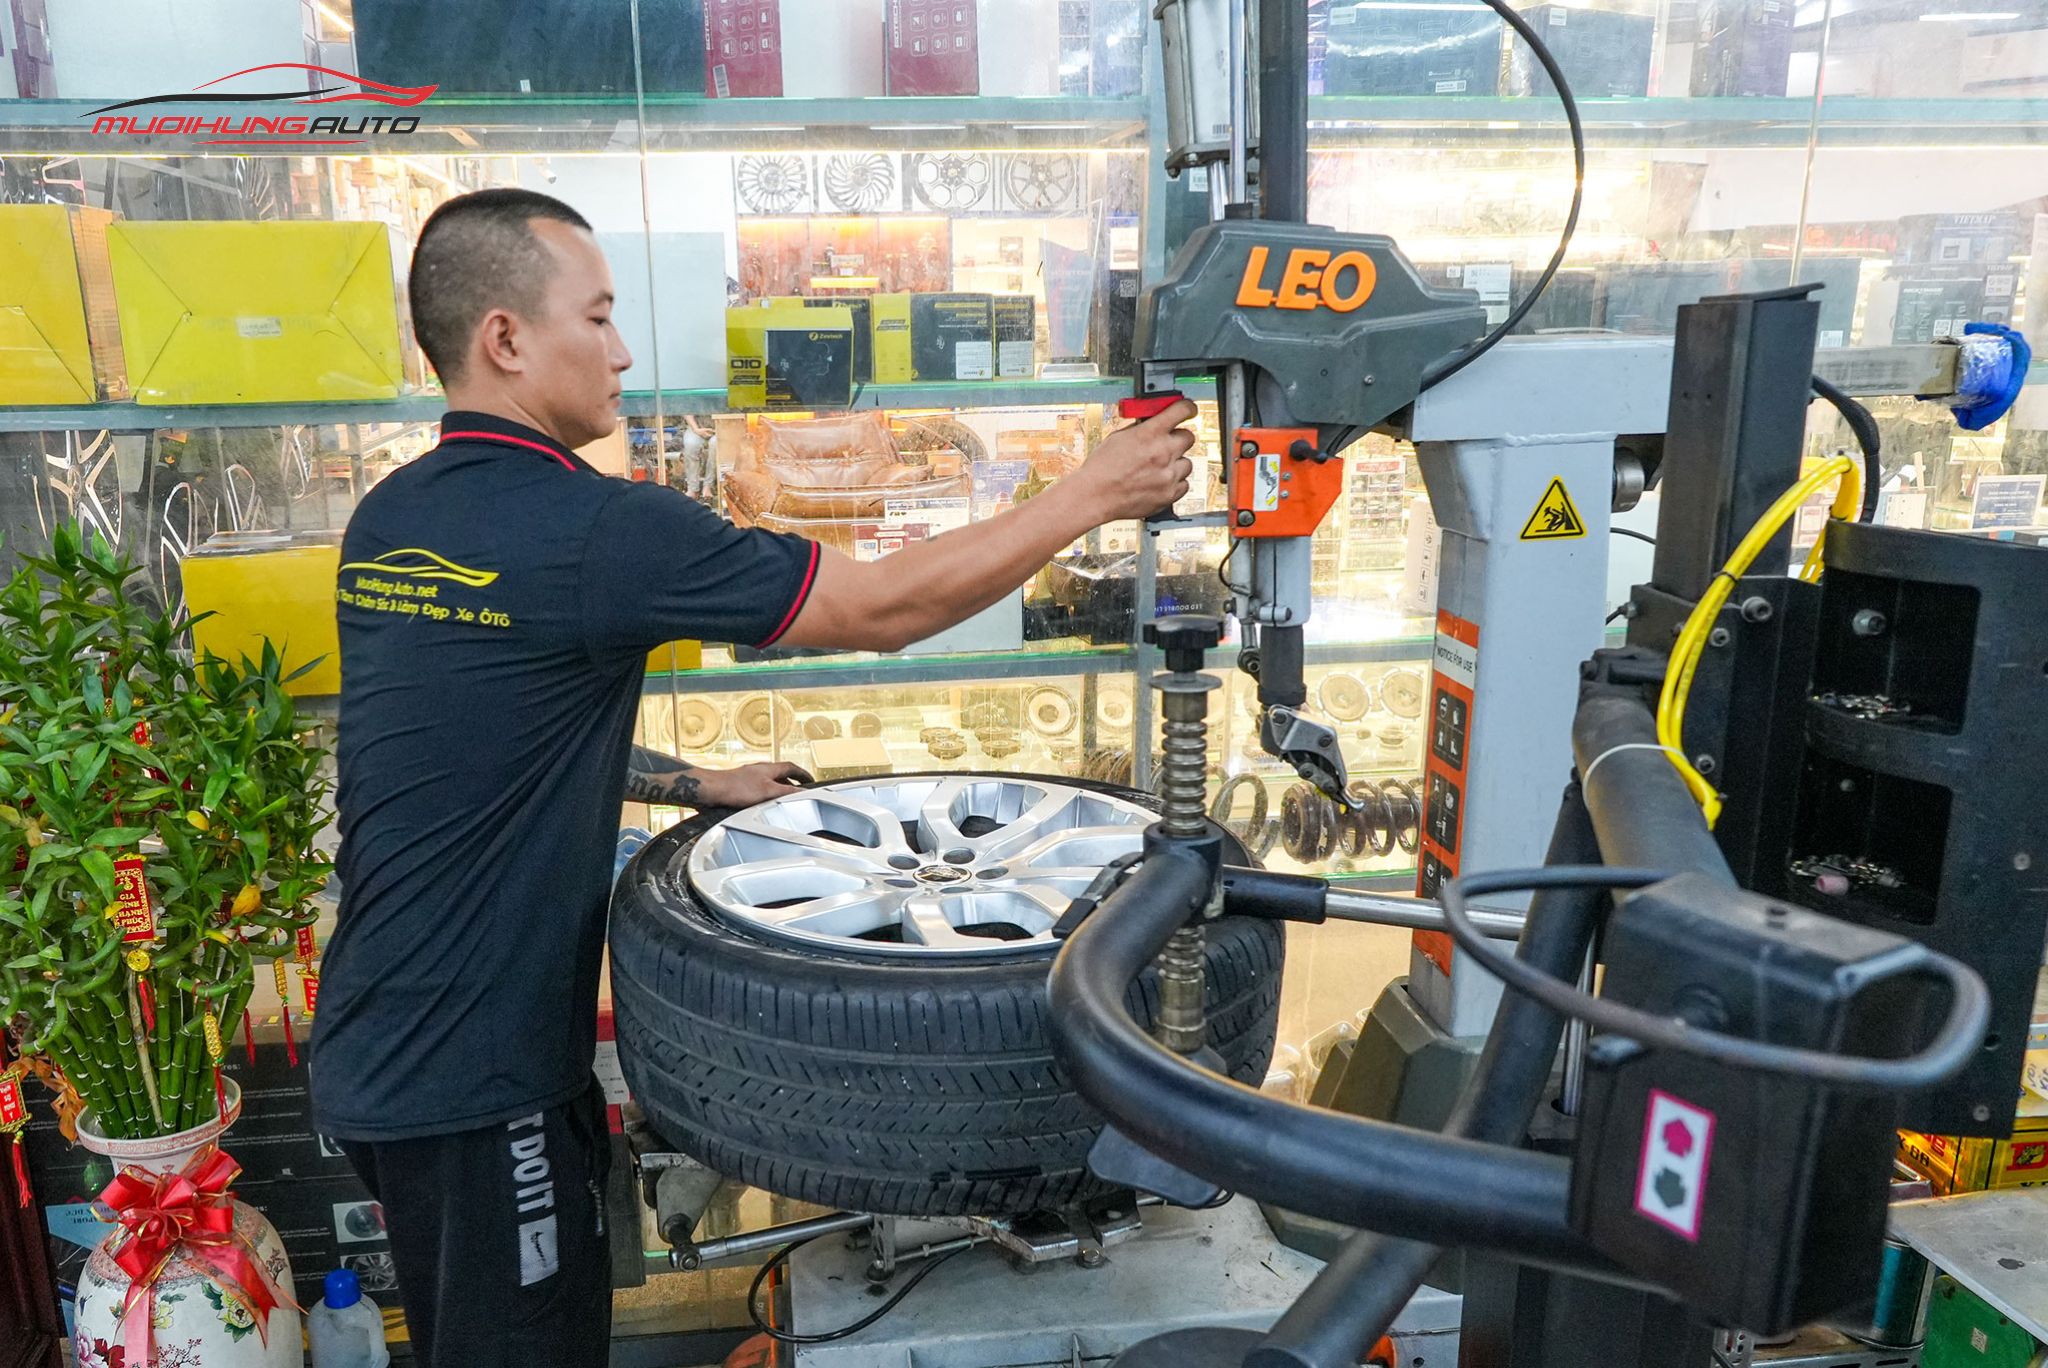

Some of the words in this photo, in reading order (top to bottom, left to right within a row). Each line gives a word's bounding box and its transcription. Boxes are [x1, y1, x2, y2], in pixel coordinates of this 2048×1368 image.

[1235, 246, 1377, 312] LEO
[422, 603, 450, 619] Đẹp
[455, 607, 475, 622] Xe
[1437, 646, 1453, 665] NOTICE
[1453, 653, 1463, 668] FOR
[1463, 660, 1473, 674] USE
[119, 893, 136, 901] GIA
